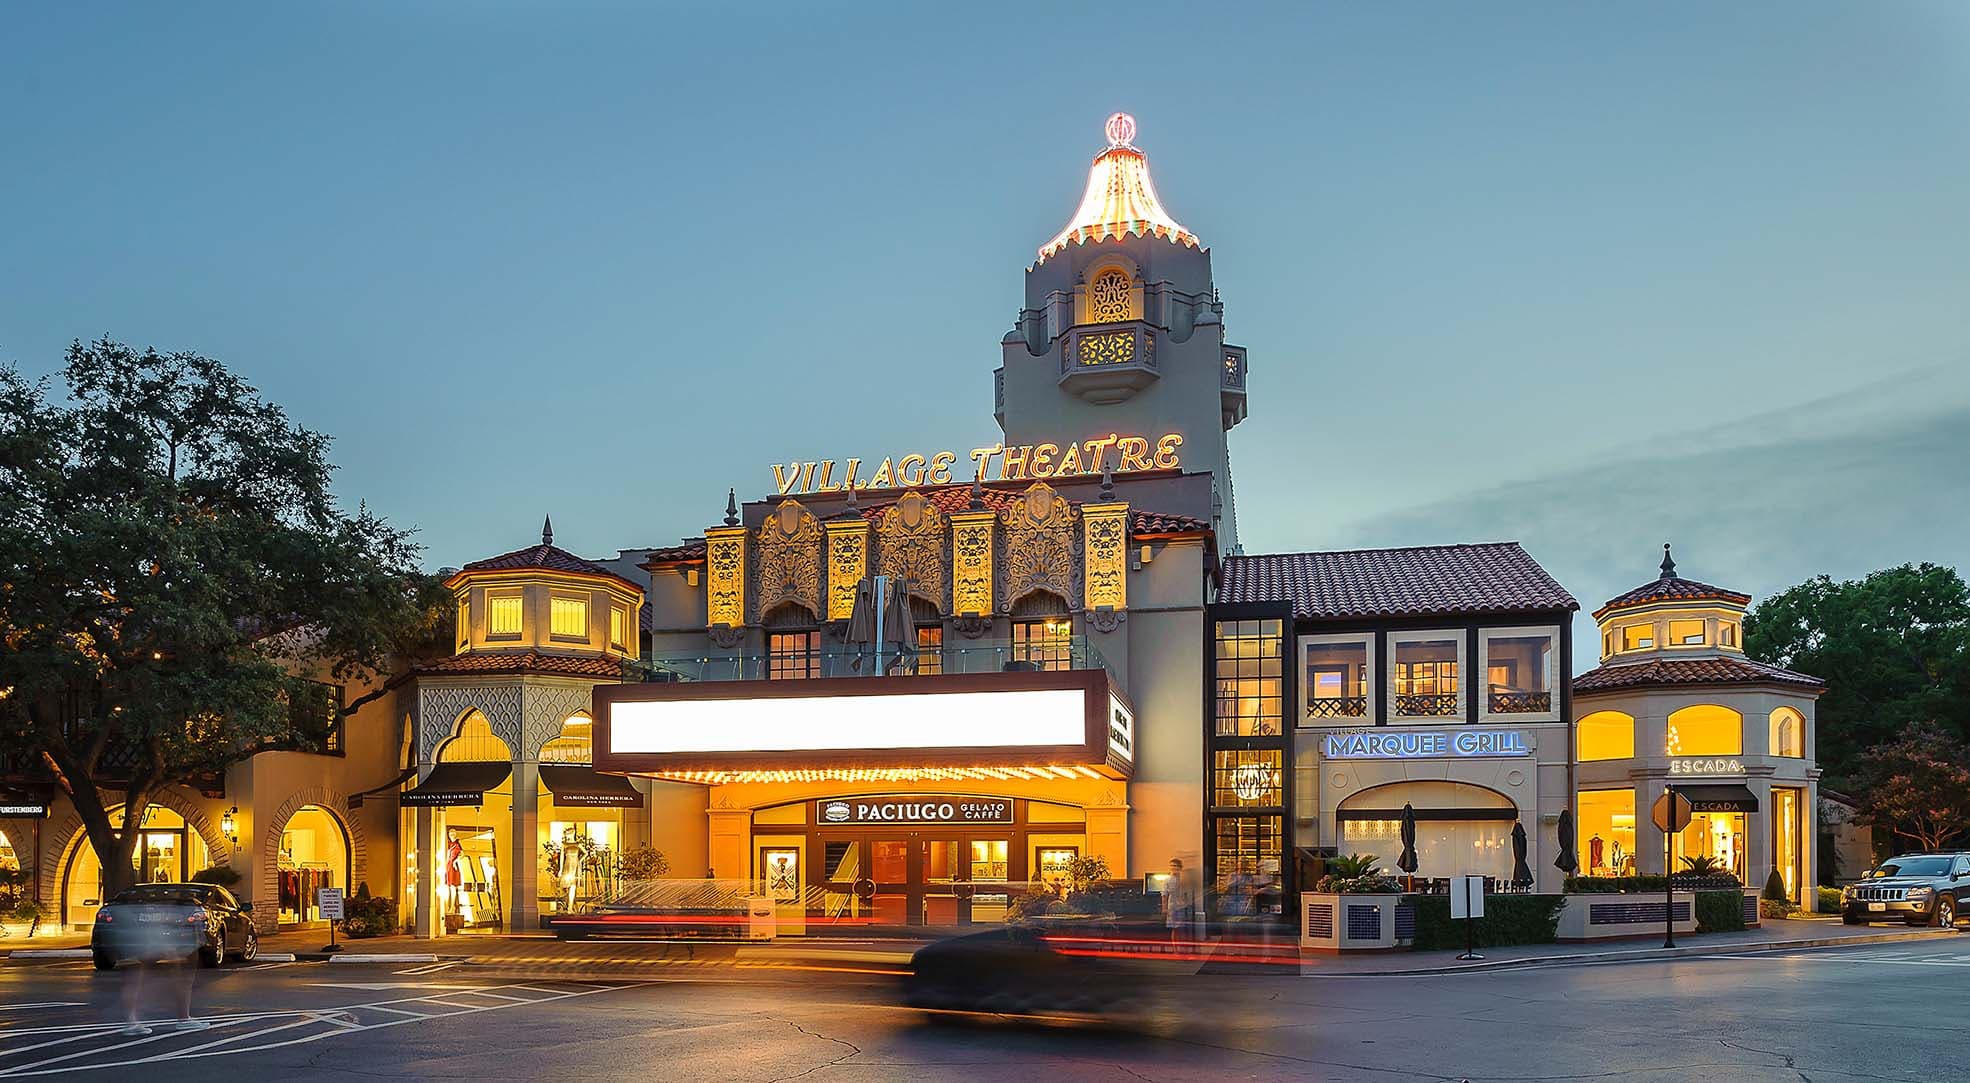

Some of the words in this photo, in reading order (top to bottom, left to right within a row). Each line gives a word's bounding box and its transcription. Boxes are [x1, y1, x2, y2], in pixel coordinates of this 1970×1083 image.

[770, 451, 956, 496] VILLAGE
[969, 433, 1184, 482] THEATRE
[1329, 735, 1447, 757] MARQUEE
[1455, 733, 1526, 754] GRILL
[1670, 760, 1740, 773] ESCADA
[857, 803, 954, 820] PACIUGO
[960, 803, 1005, 811] GELATO
[1693, 802, 1740, 811] ESCADA
